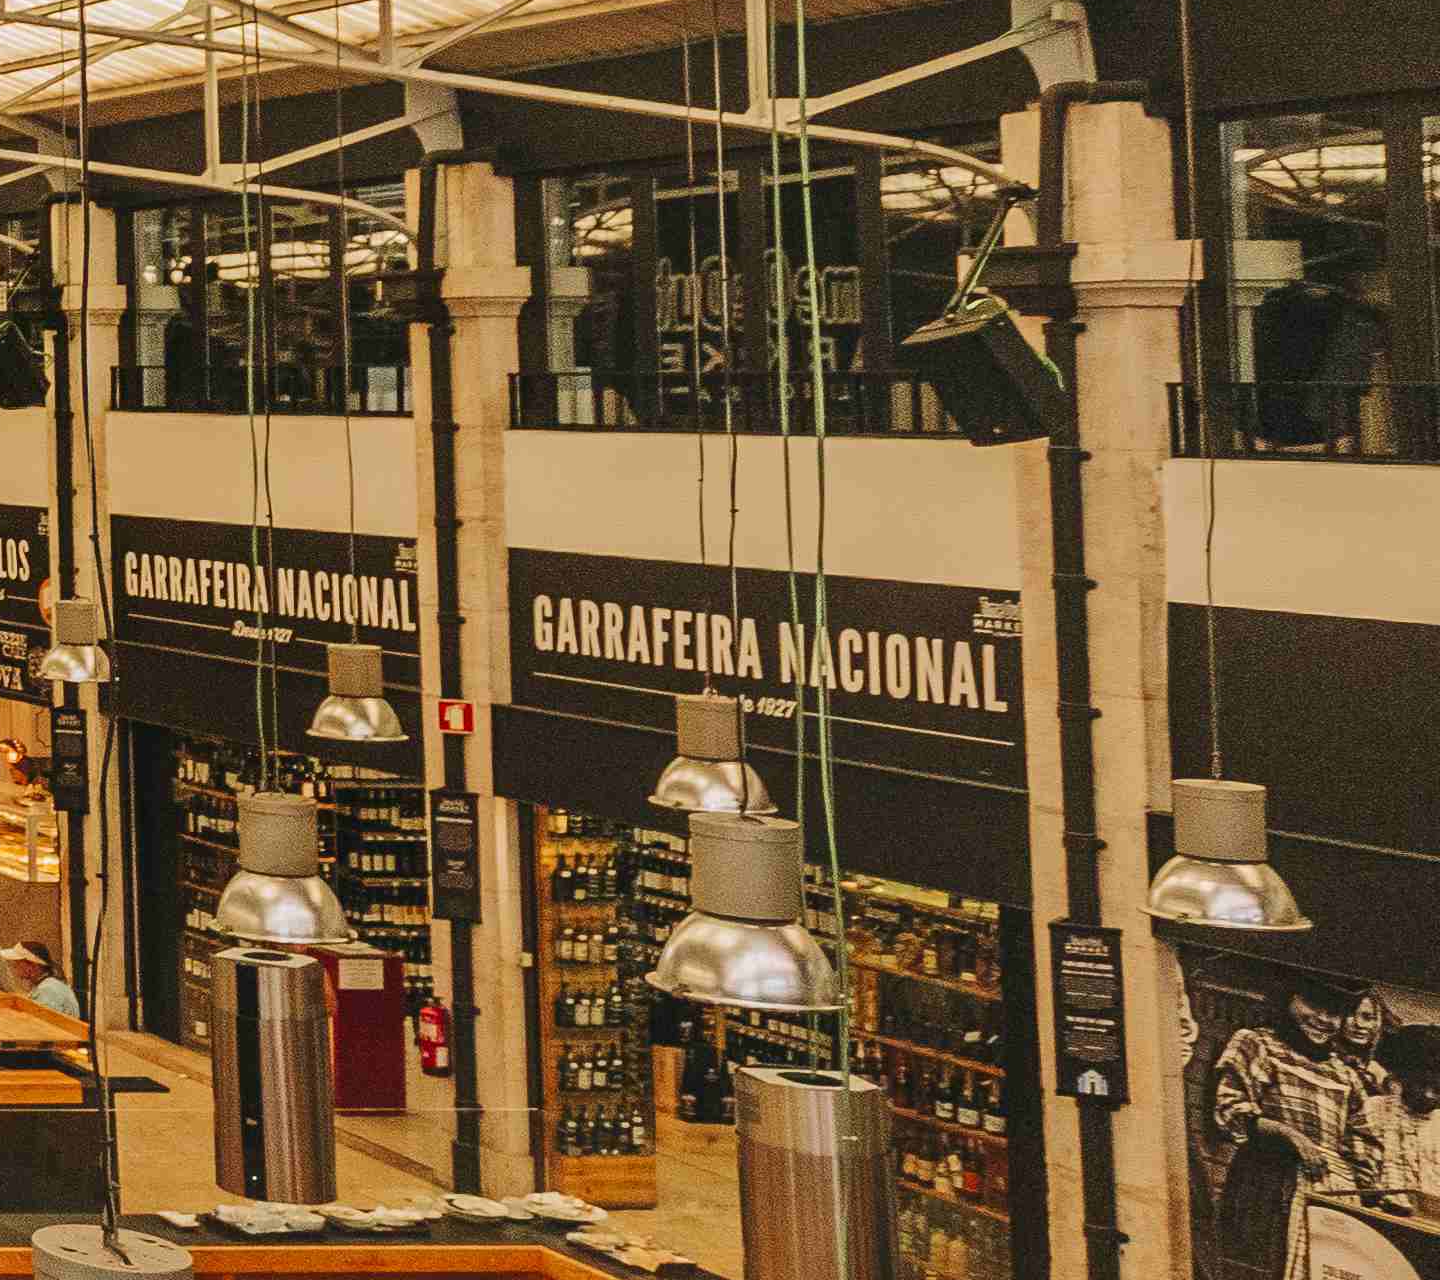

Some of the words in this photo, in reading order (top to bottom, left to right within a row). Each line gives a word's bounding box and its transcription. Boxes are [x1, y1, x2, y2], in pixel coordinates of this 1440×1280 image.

[124, 551, 269, 614] GARRAFEIRA
[277, 567, 417, 633] NACIONAL
[973, 617, 1023, 634] MARKE
[532, 594, 763, 680] GARRAFEIRA
[779, 620, 1008, 713] NACIONAL
